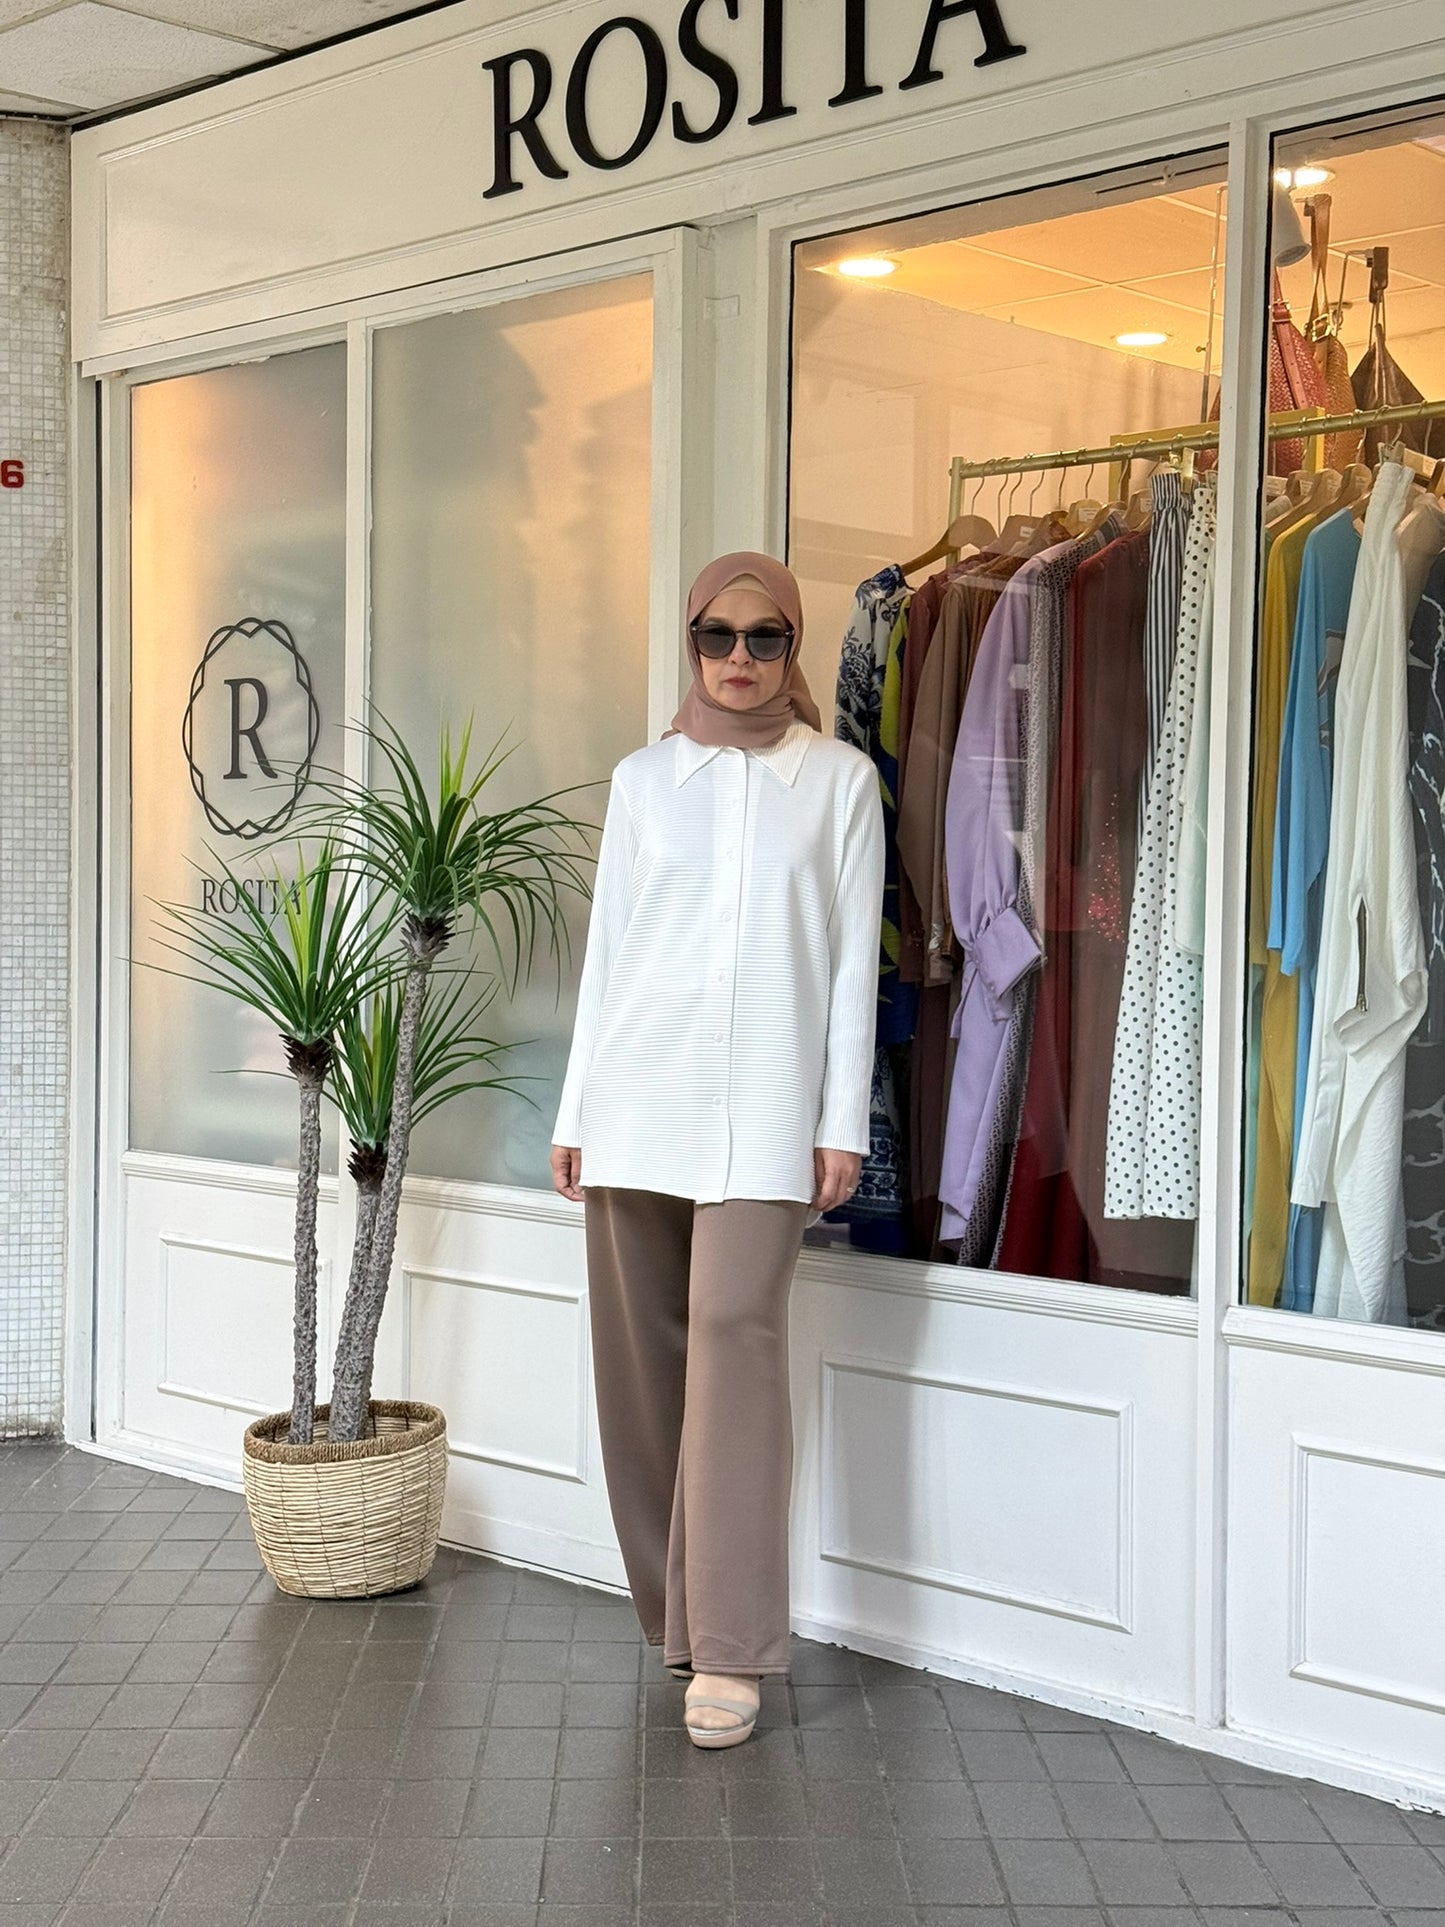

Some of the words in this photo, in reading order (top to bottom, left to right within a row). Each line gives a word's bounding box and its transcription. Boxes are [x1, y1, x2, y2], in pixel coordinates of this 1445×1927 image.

[482, 0, 1026, 199] ROSITA
[1, 460, 24, 488] 6
[223, 677, 278, 780] R
[201, 879, 301, 915] ROSITA
